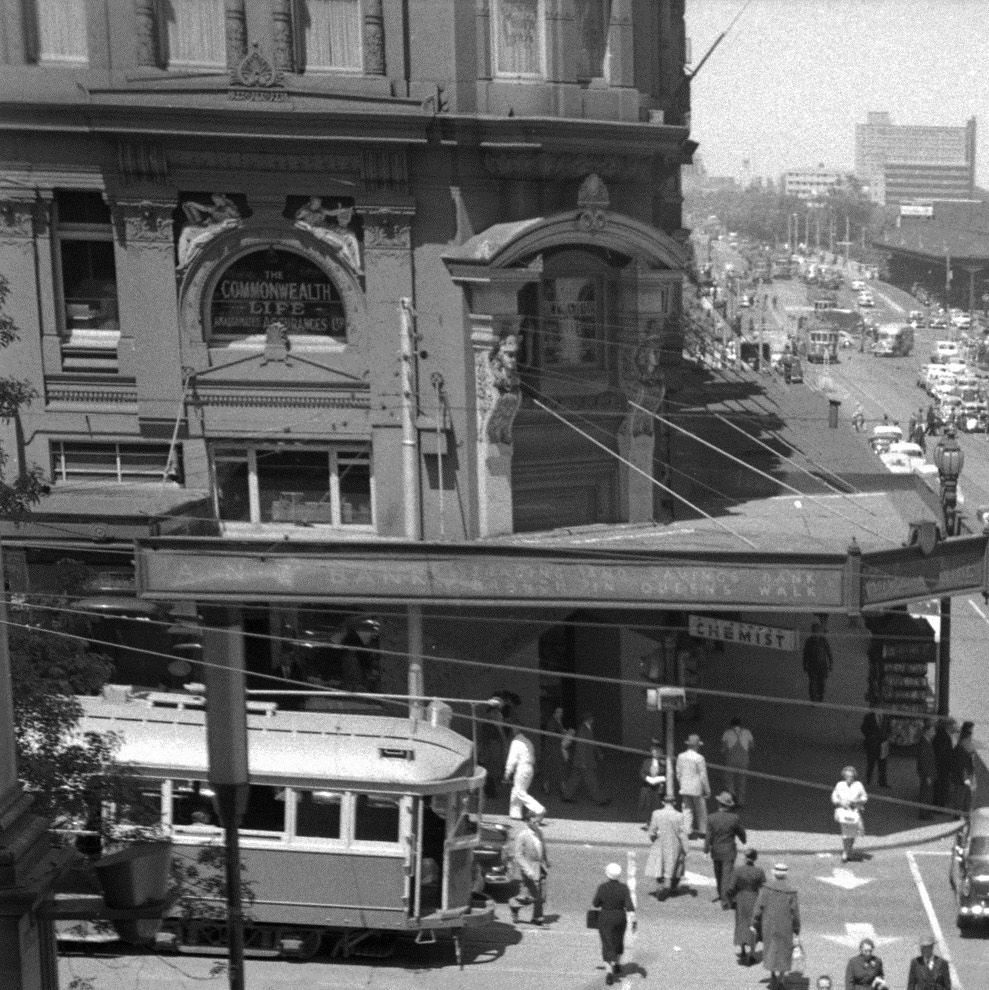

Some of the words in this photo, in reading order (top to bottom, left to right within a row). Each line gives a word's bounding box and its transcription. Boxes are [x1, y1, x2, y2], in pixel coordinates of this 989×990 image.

[264, 270, 283, 280] THE
[220, 280, 332, 301] COMMONWEALTH
[249, 301, 305, 316] LIFE
[758, 585, 816, 598] WALK
[696, 621, 785, 648] CHEMIST
